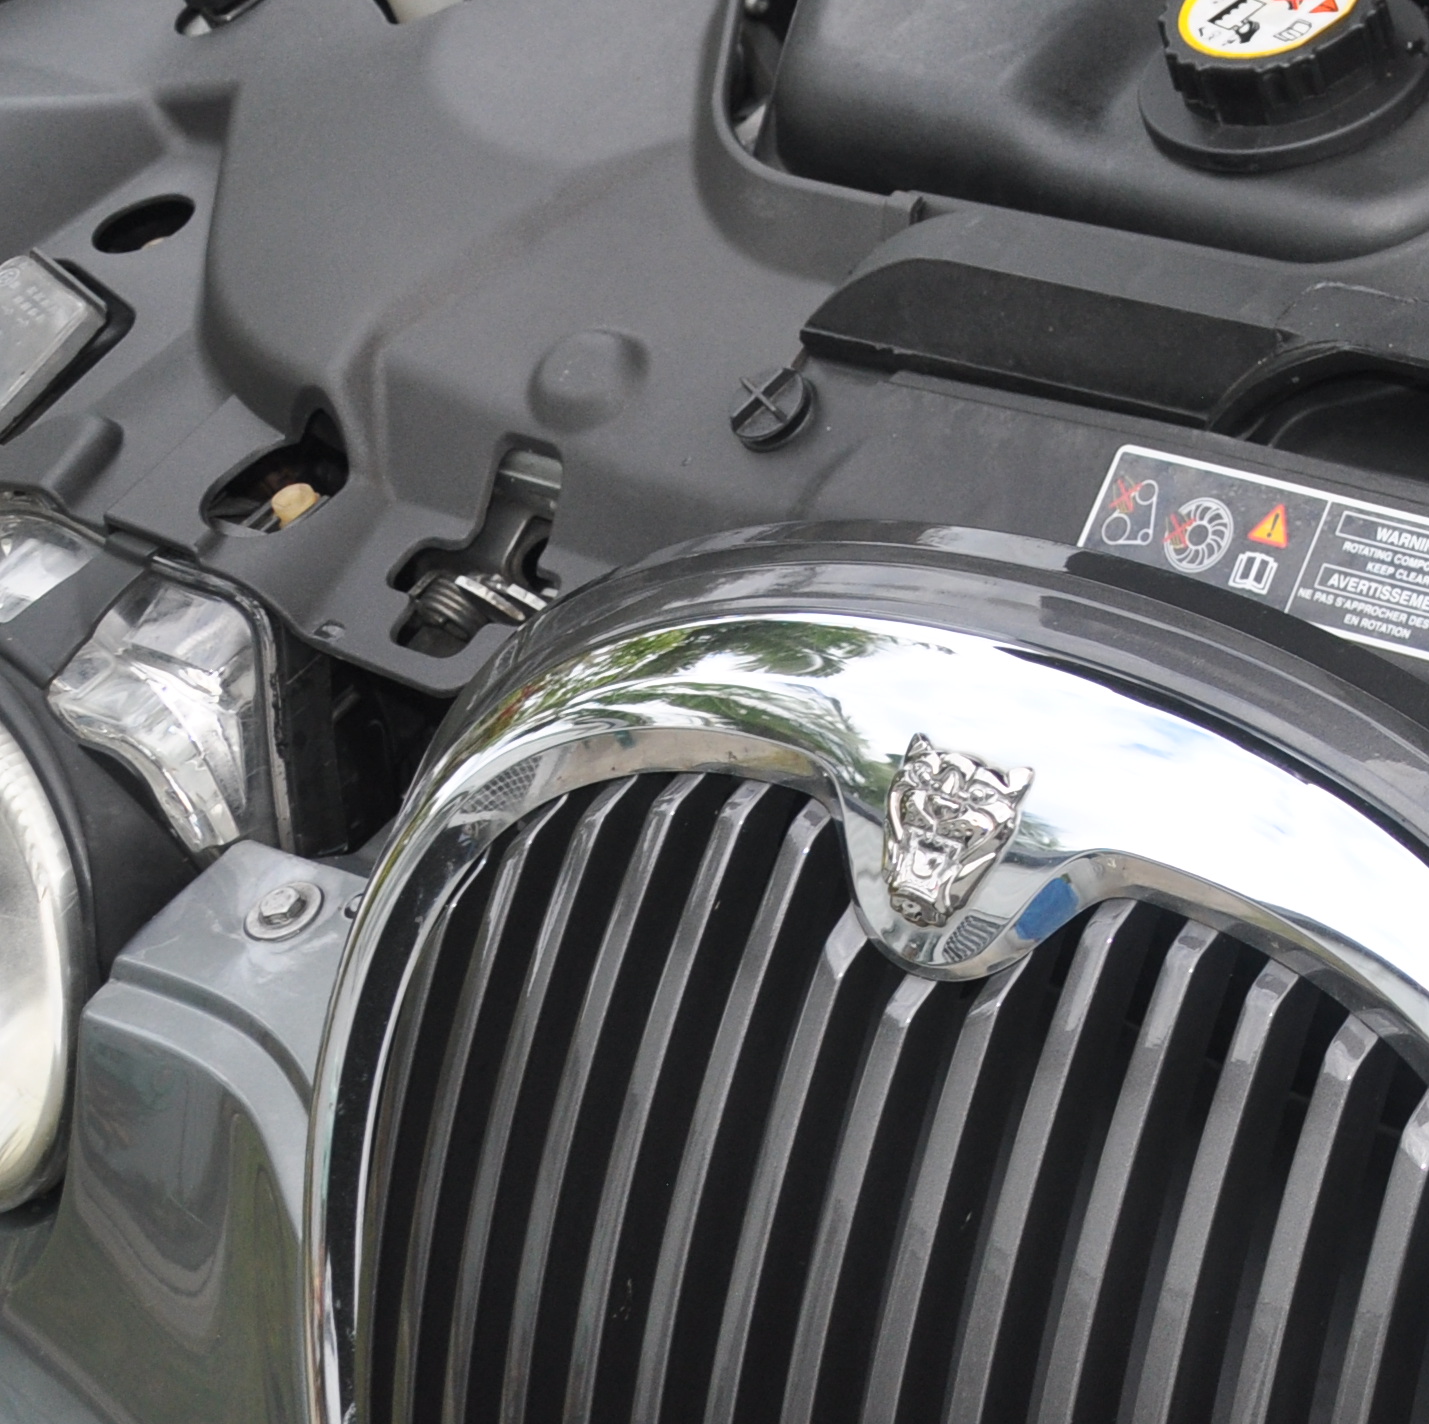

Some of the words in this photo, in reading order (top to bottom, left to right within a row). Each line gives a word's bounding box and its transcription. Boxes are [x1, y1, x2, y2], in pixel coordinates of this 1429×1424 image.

[1342, 541, 1392, 562] ROTATING
[1365, 561, 1396, 575] KEEP
[1297, 587, 1311, 600] NE
[1313, 590, 1335, 605] PAS
[1335, 597, 1408, 624] S'APPROCHER
[1343, 613, 1360, 626] EN
[1361, 618, 1411, 639] ROTATION
